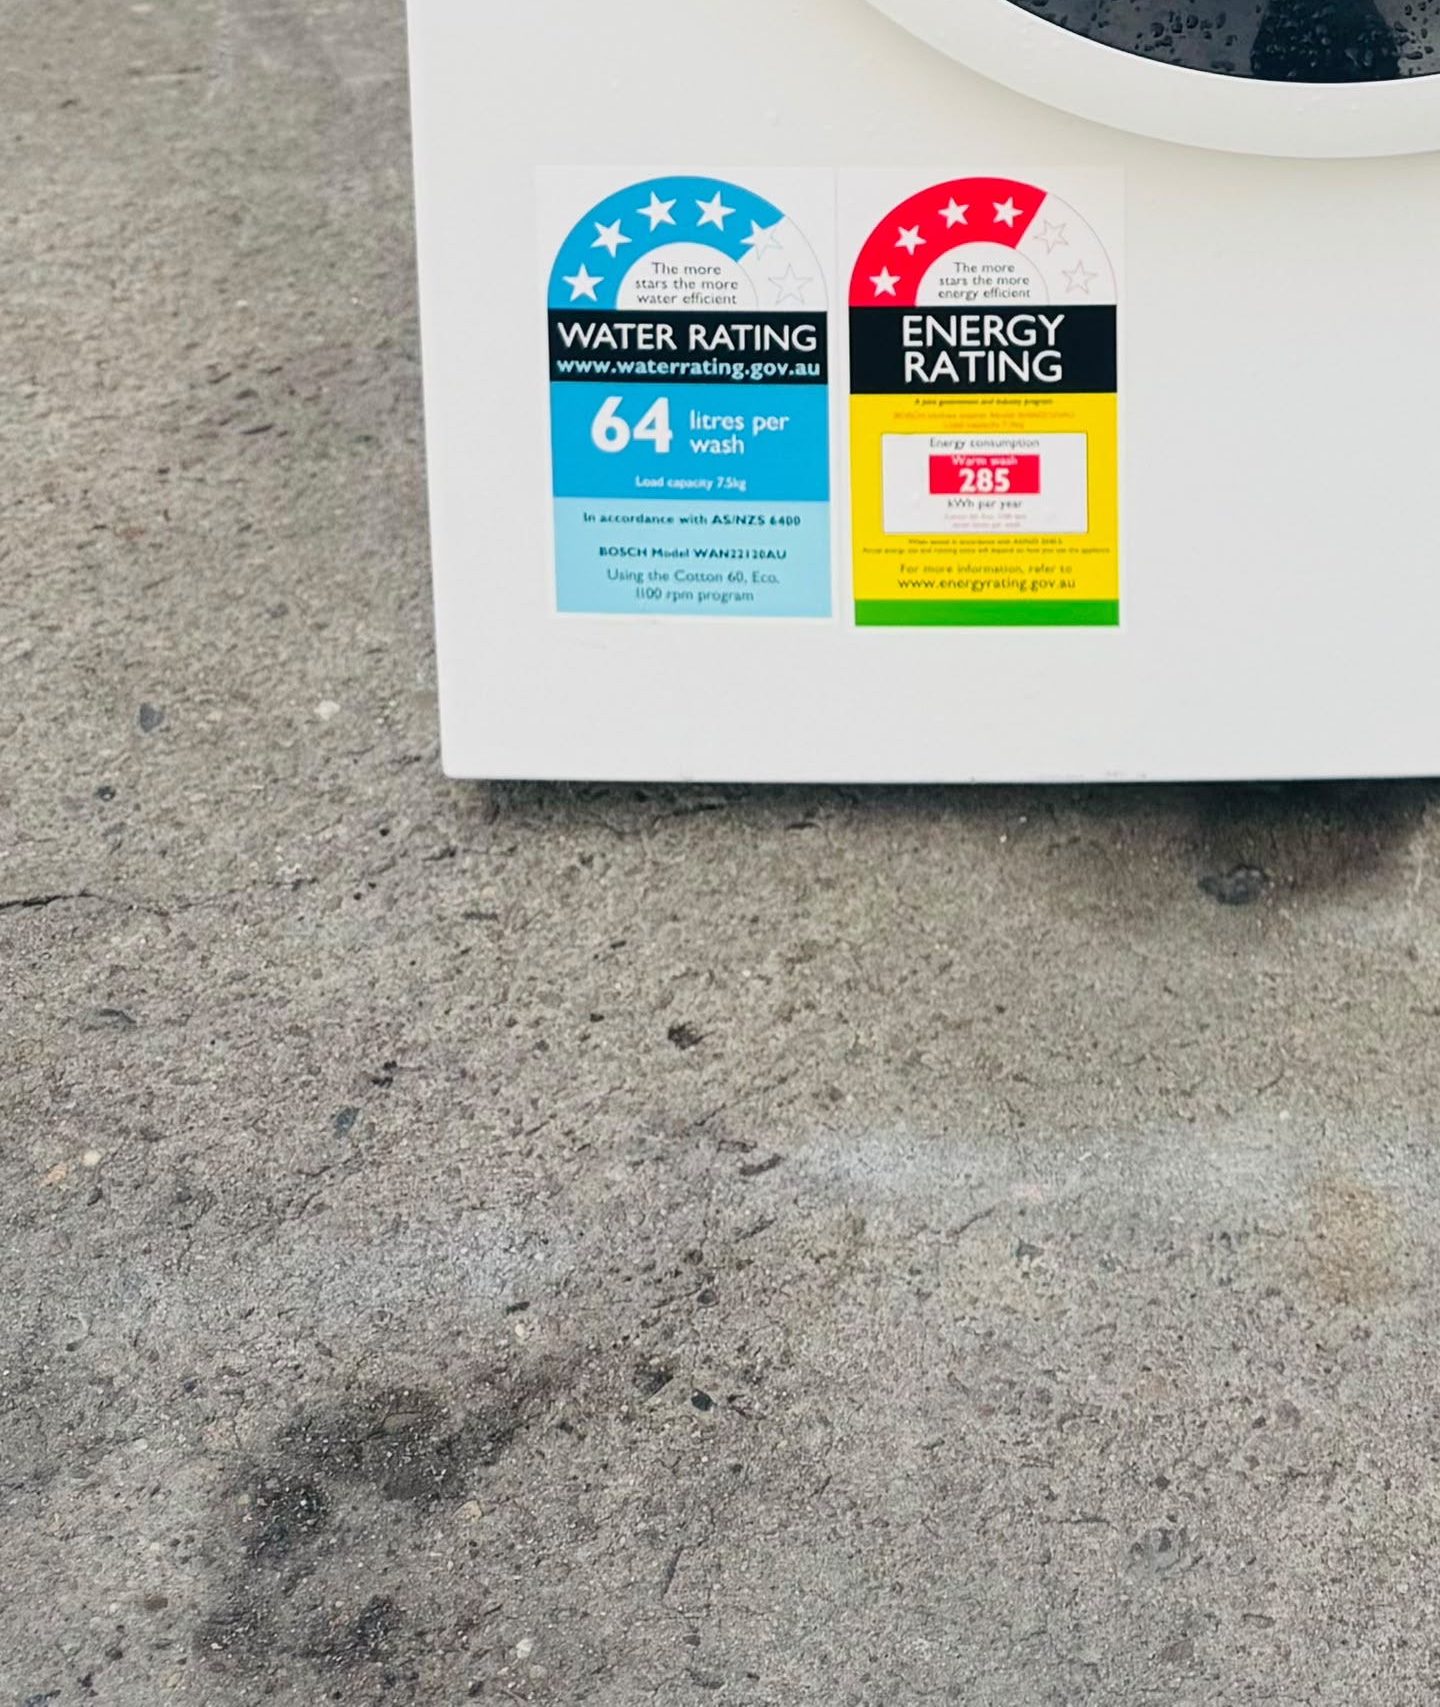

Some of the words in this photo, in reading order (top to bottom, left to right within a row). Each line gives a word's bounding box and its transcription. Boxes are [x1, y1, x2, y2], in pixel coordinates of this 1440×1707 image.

[652, 262, 679, 275] The
[684, 264, 721, 275] more
[954, 262, 980, 273] The
[984, 264, 1014, 273] more
[635, 279, 669, 290] stars
[675, 277, 699, 290] the
[704, 279, 738, 290] more
[939, 276, 968, 286] stars
[972, 275, 996, 286] the
[1000, 277, 1029, 286] more
[636, 294, 677, 305] water
[682, 292, 737, 305] efficient
[938, 289, 978, 300] energy
[984, 288, 1030, 299] efficient
[558, 322, 677, 351] WATER
[690, 324, 818, 352] RATING
[903, 315, 1064, 347] ENERGY
[557, 358, 820, 380] www.waterrating.gov.au
[905, 352, 1063, 382] RATING
[590, 396, 674, 453] 64
[690, 410, 745, 432] litres
[752, 413, 789, 439] per
[690, 434, 744, 455] wash
[930, 438, 966, 452] Energy
[970, 439, 1040, 451] consumption
[635, 475, 664, 488] Load
[667, 477, 713, 491] capacity
[958, 468, 1010, 493] 285
[1000, 500, 1023, 511] year
[583, 512, 596, 523] In
[599, 513, 674, 524] accordance
[680, 514, 707, 525] with
[712, 514, 765, 526] AS/NZS
[599, 546, 648, 558] BOSCH
[651, 547, 690, 559] Model
[607, 568, 644, 583] Using
[648, 569, 669, 582] the
[674, 570, 723, 583] Cotton
[899, 563, 918, 574] For
[923, 565, 953, 574] more
[666, 590, 693, 603] rpm
[698, 590, 754, 604] program
